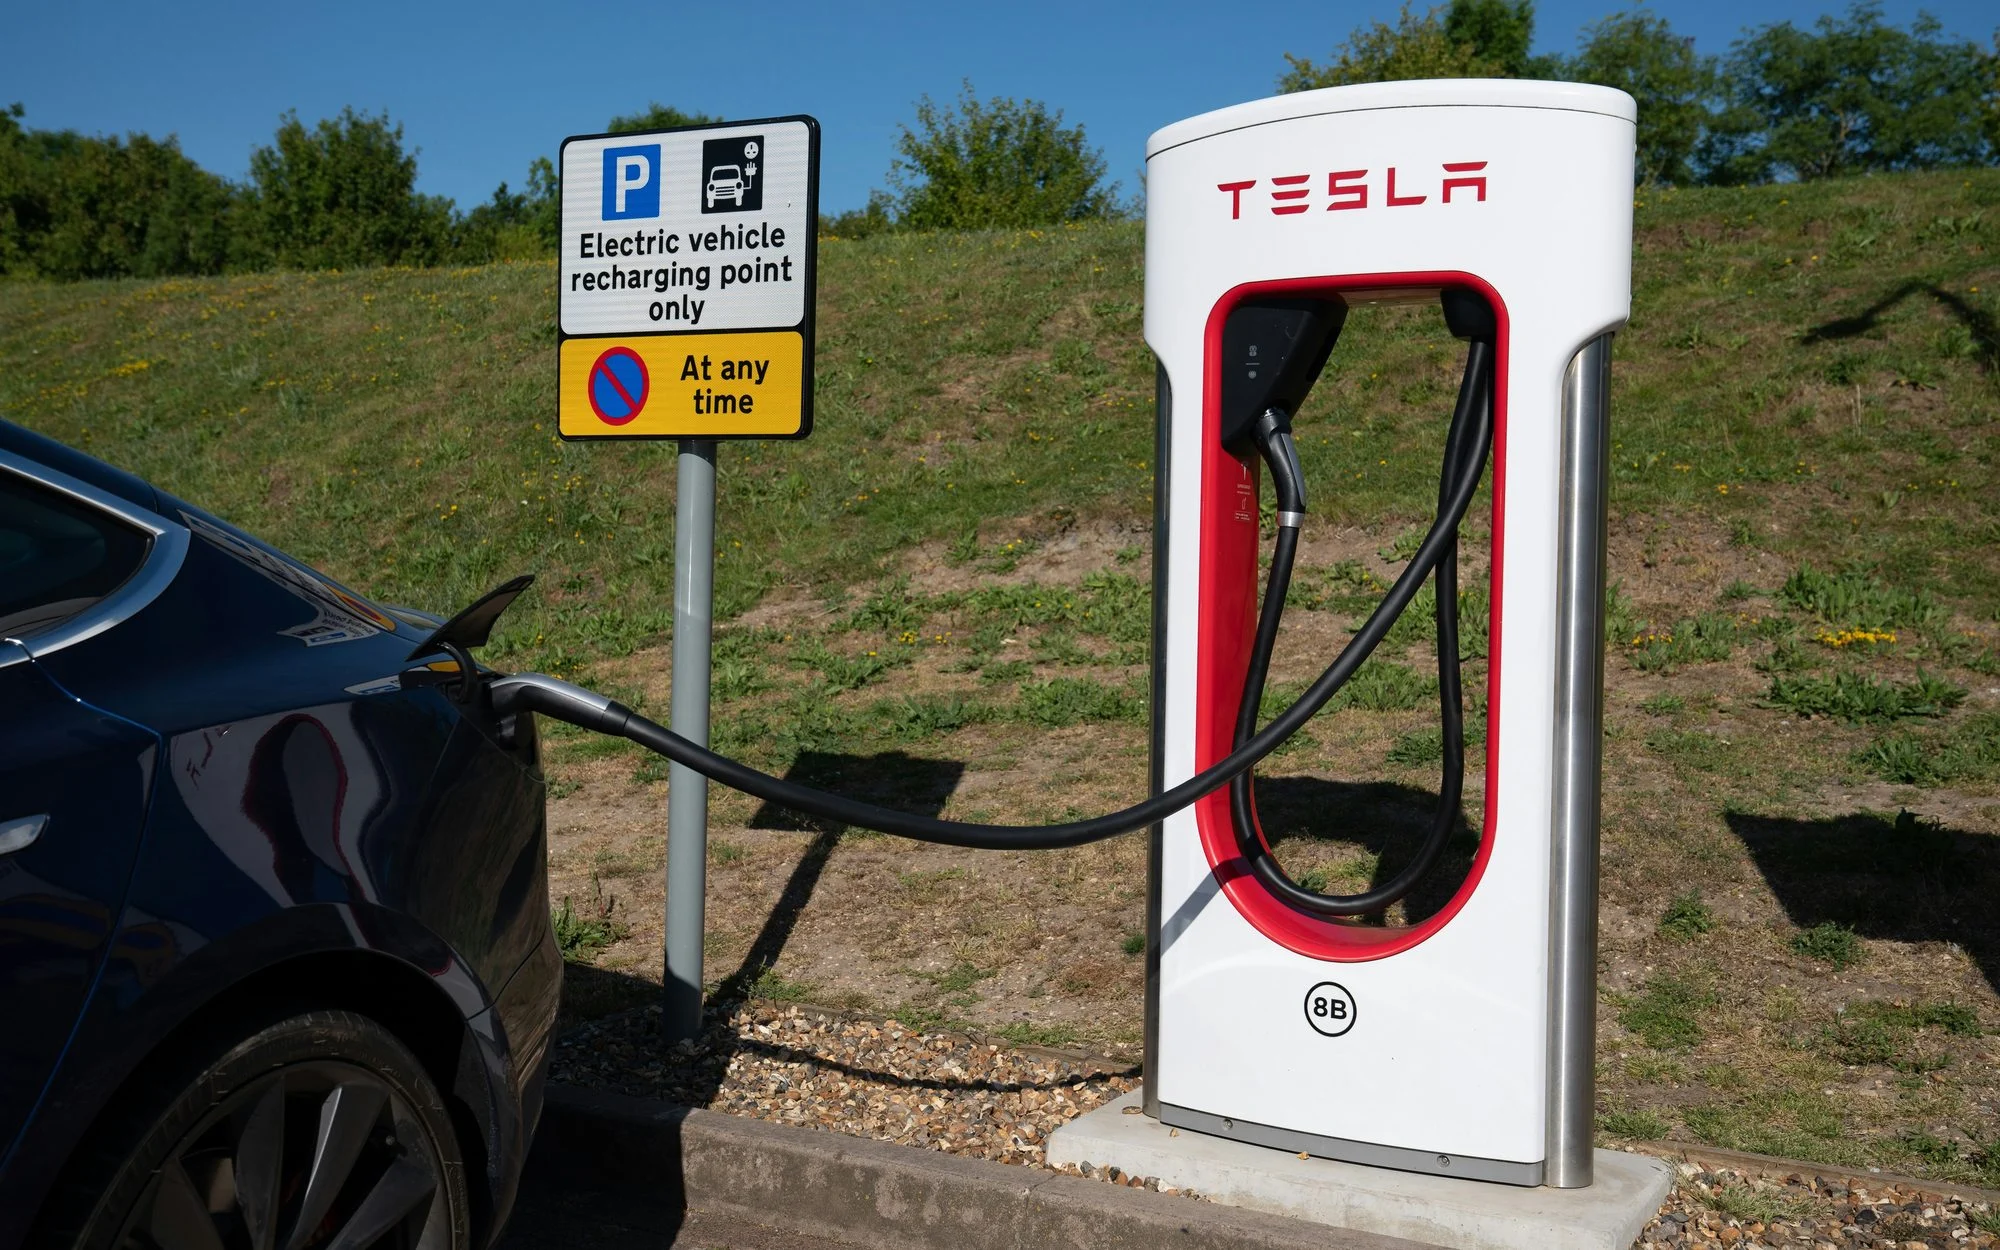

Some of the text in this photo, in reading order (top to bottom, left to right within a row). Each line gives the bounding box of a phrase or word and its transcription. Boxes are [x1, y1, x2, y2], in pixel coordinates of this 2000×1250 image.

[615, 154, 650, 213] P
[1217, 161, 1488, 220] TESLA
[580, 221, 786, 259] Electric vehicle
[571, 254, 793, 293] recharging point
[648, 293, 706, 325] only
[680, 354, 770, 385] At any
[693, 387, 754, 415] time
[1313, 996, 1348, 1020] 8B
